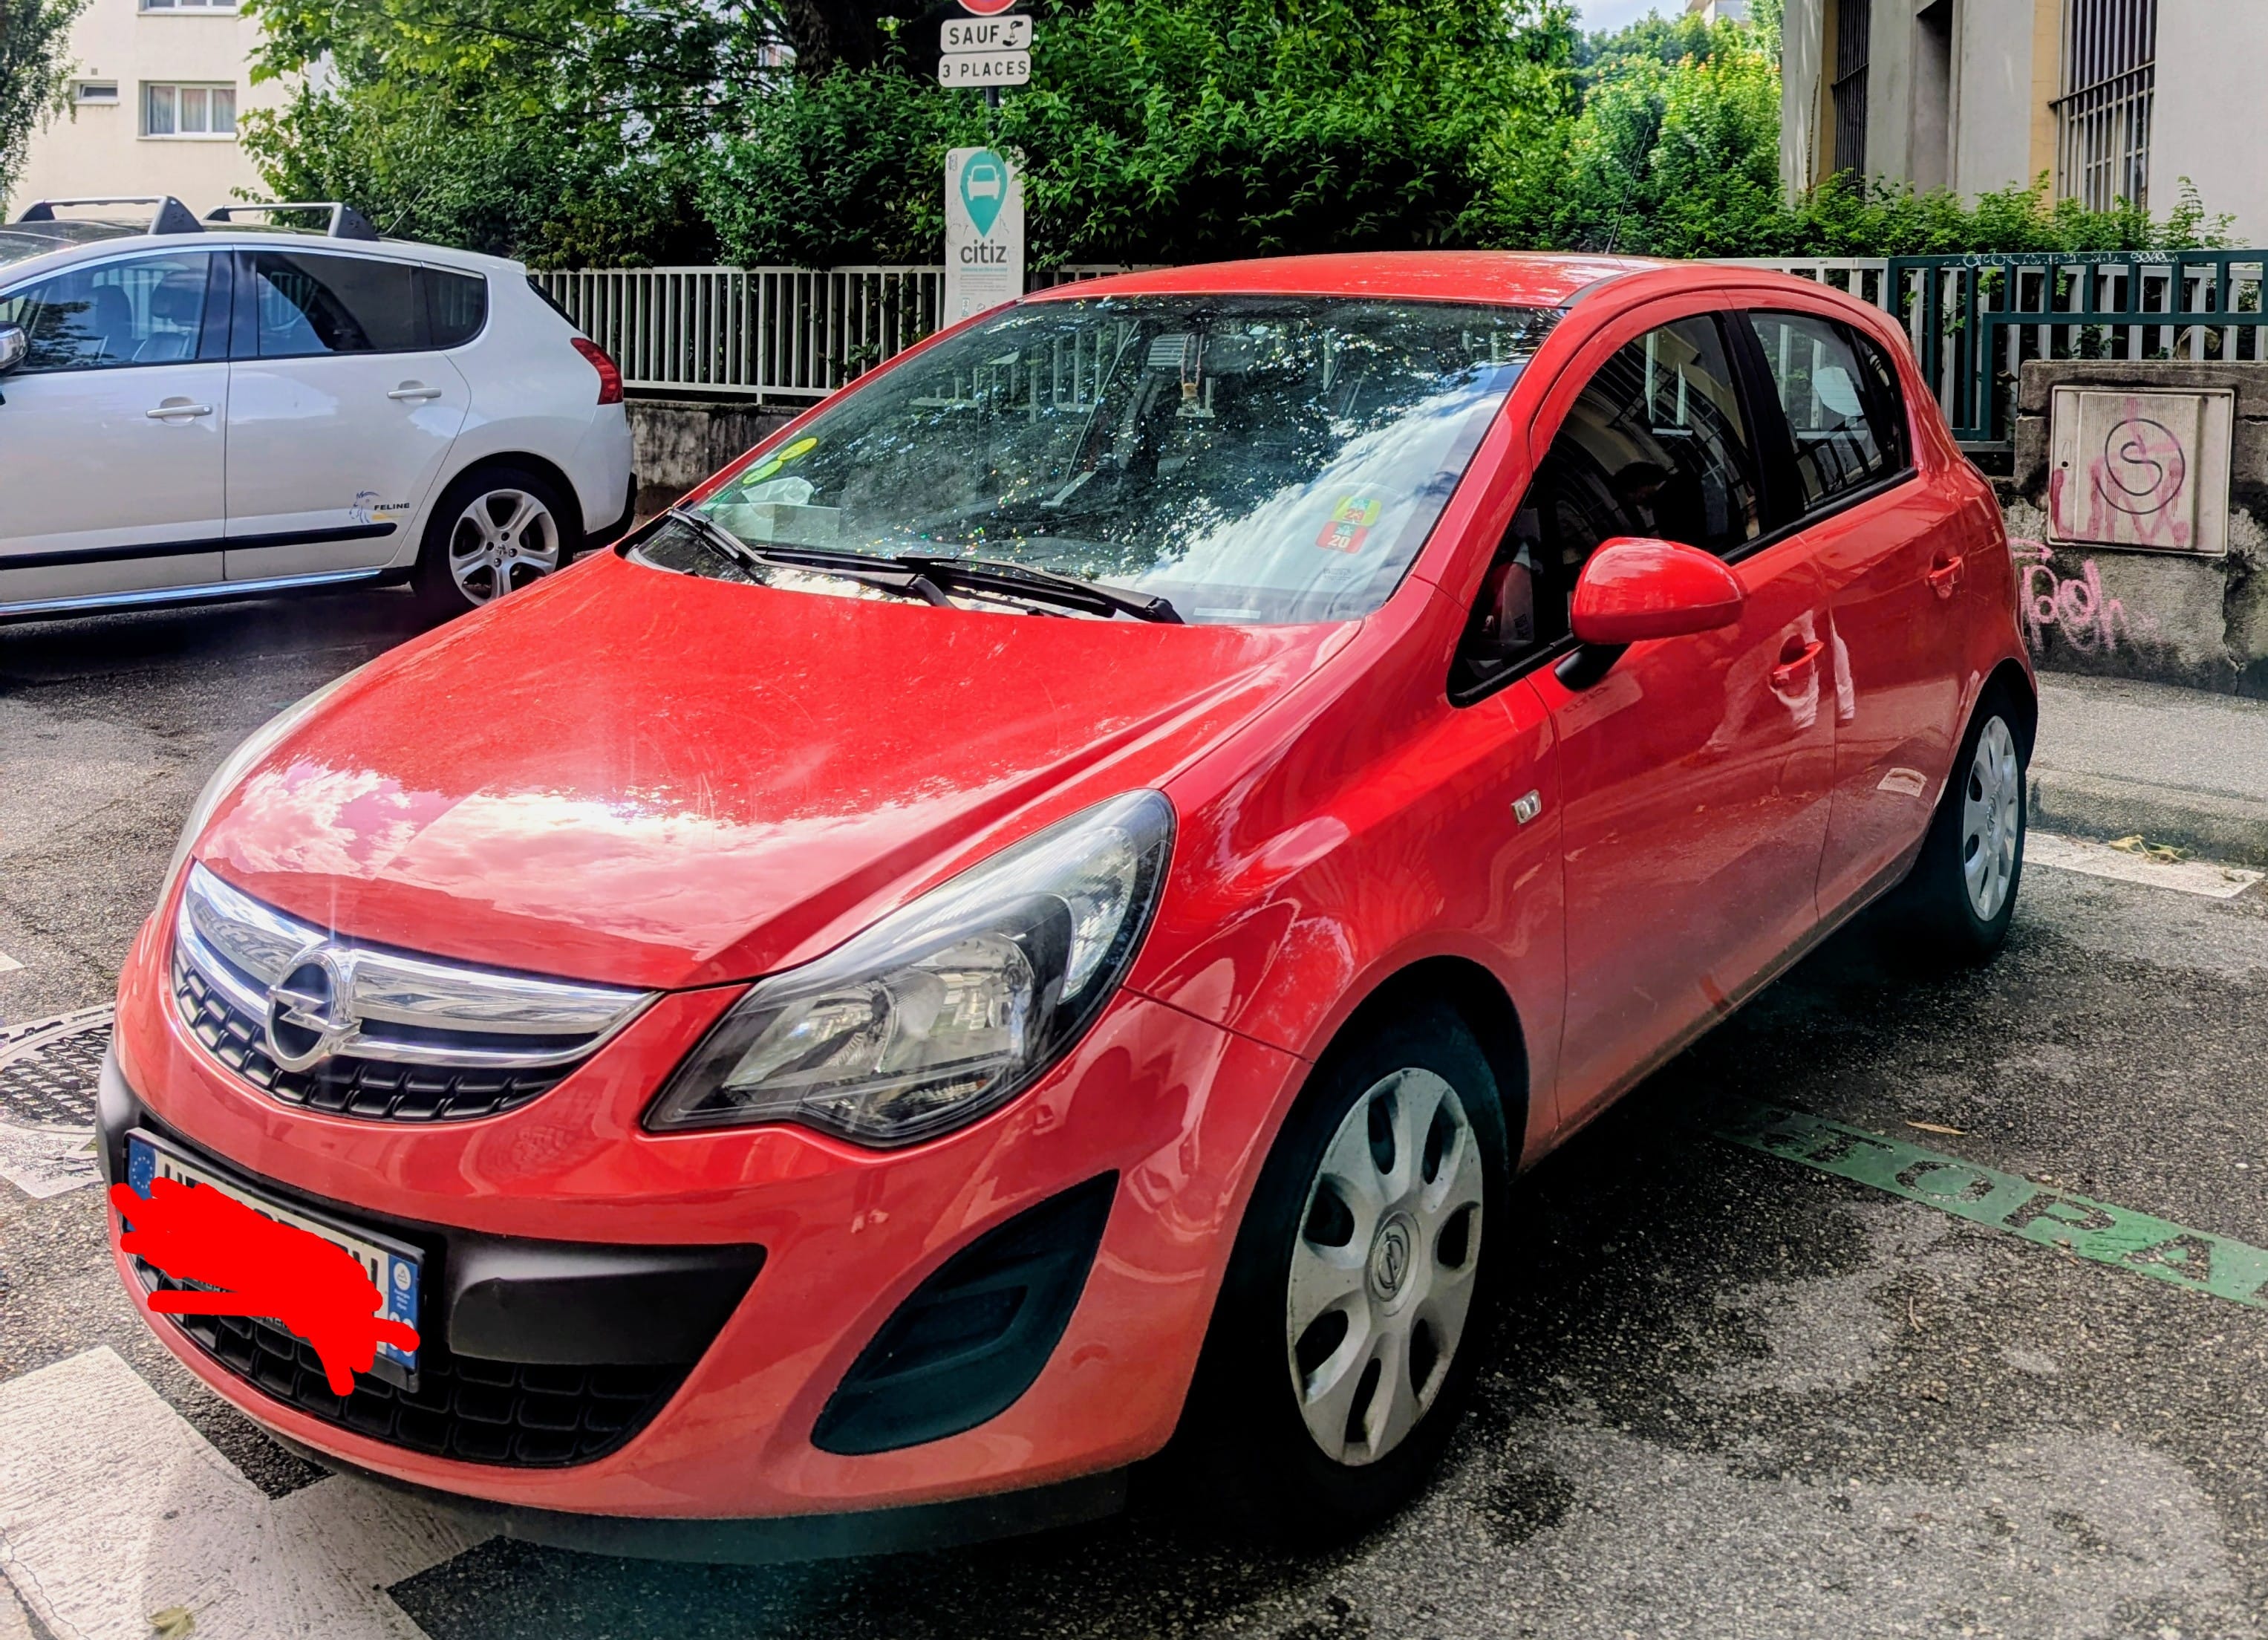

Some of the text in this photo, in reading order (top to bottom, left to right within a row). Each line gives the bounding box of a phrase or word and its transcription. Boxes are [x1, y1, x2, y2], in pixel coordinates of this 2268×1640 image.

[949, 25, 1000, 45] SAUF
[942, 61, 1027, 78] 3 PLACES
[960, 238, 1007, 264] citiz
[1328, 535, 1350, 547] 20
[1753, 1110, 2268, 1302] TOPA
